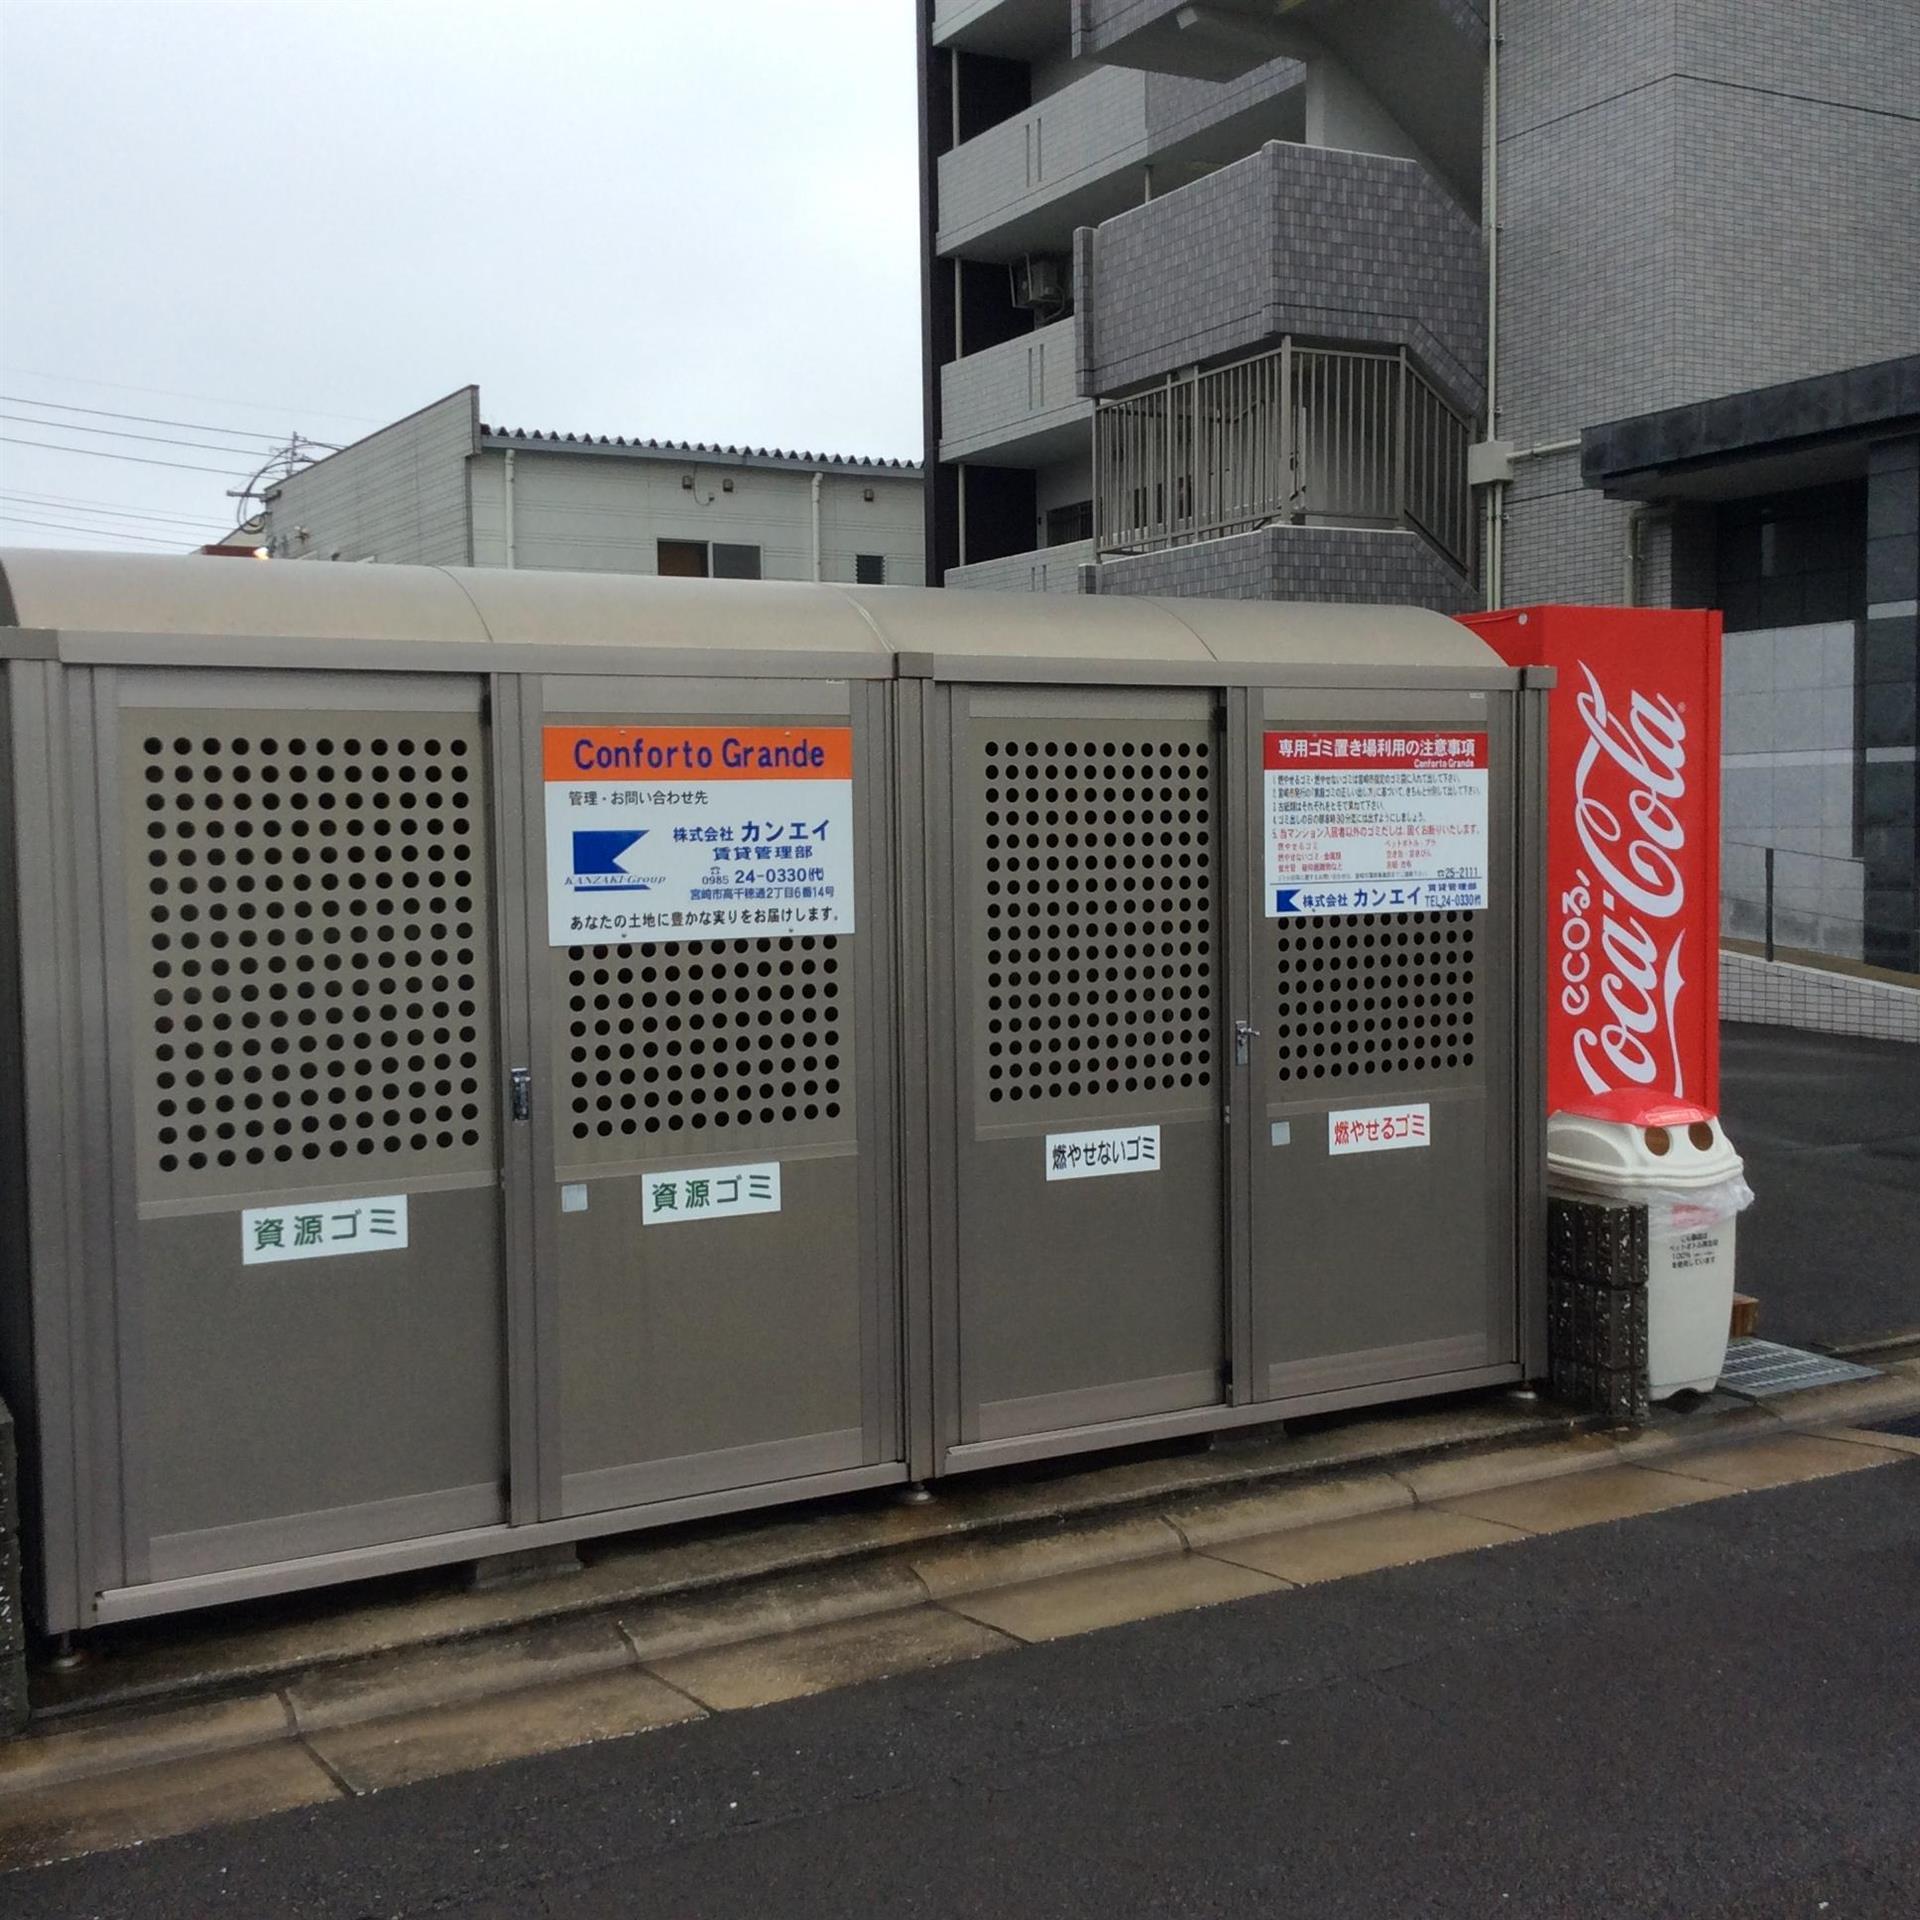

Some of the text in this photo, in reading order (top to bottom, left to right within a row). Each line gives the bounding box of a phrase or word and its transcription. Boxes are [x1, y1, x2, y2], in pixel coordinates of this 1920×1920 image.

[574, 738, 825, 770] Conforto Grande
[1278, 738, 1476, 758] 専用ゴミ置き場利用の注意事項
[568, 790, 709, 806] 管理・お問い合わせ先
[673, 819, 830, 843] 株式会社 カンエイ
[712, 845, 814, 861] 賃貸管理部
[702, 875, 729, 885] 0985
[1574, 660, 1686, 1095] Coca-Cola
[690, 886, 835, 901] 宮崎市高千穂通2丁目6番14号
[1303, 886, 1421, 908] 株式会社 カンエイ
[570, 905, 839, 930] あなたの土地に豊かな実りをお届けします。
[1334, 1113, 1426, 1146] 燃やせるゴミ
[1052, 1136, 1156, 1171] 燃やせないゴミ
[651, 1174, 772, 1213] 資源ゴミ
[254, 1208, 397, 1251] 資源ゴミ
